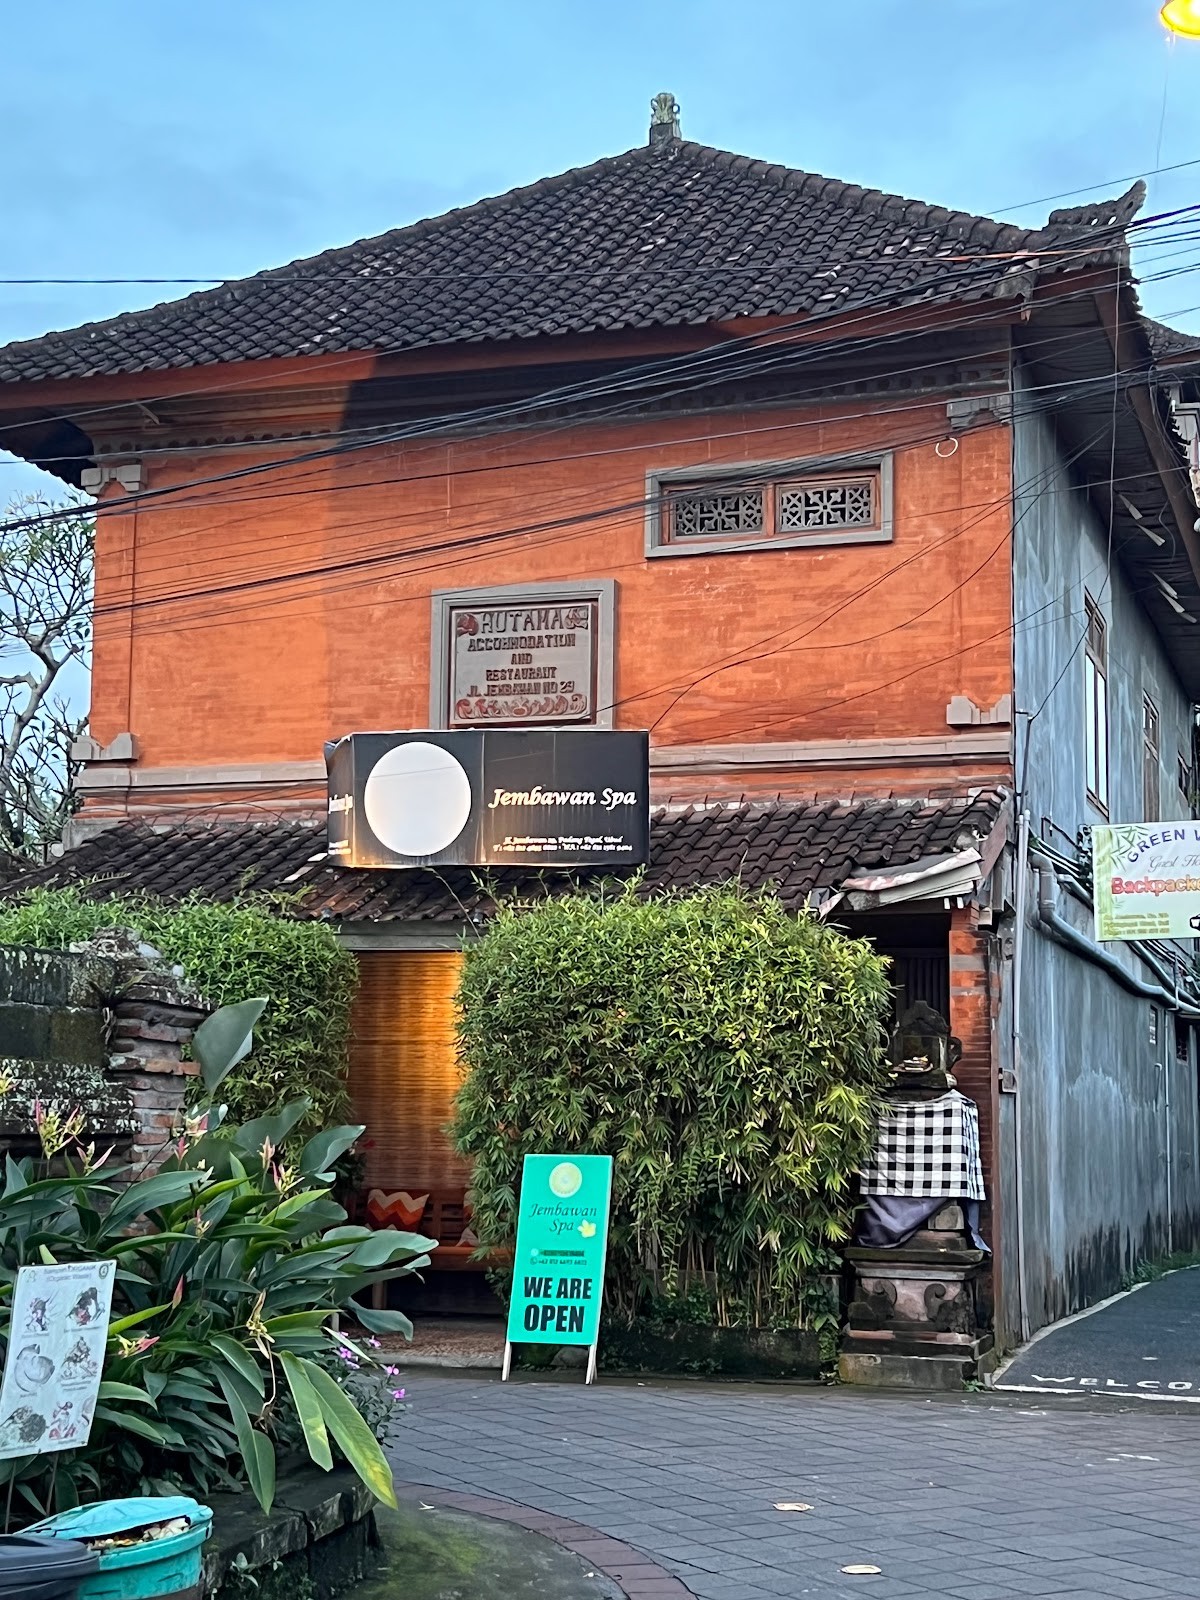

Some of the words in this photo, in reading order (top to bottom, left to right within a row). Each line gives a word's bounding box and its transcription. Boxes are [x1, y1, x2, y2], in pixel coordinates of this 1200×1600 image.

[511, 653, 533, 665] AND
[486, 666, 557, 681] RESTAURANT
[484, 682, 541, 697] JEMBAWAN
[488, 786, 596, 809] Jembawan
[600, 787, 637, 811] Spa
[1127, 829, 1185, 863] GREEN
[528, 1202, 597, 1218] Jembawan
[549, 1218, 574, 1235] Spa
[524, 1276, 553, 1299] WE
[556, 1277, 592, 1300] ARE
[523, 1304, 585, 1333] OPEN
[1031, 1374, 1200, 1390] WELCO
